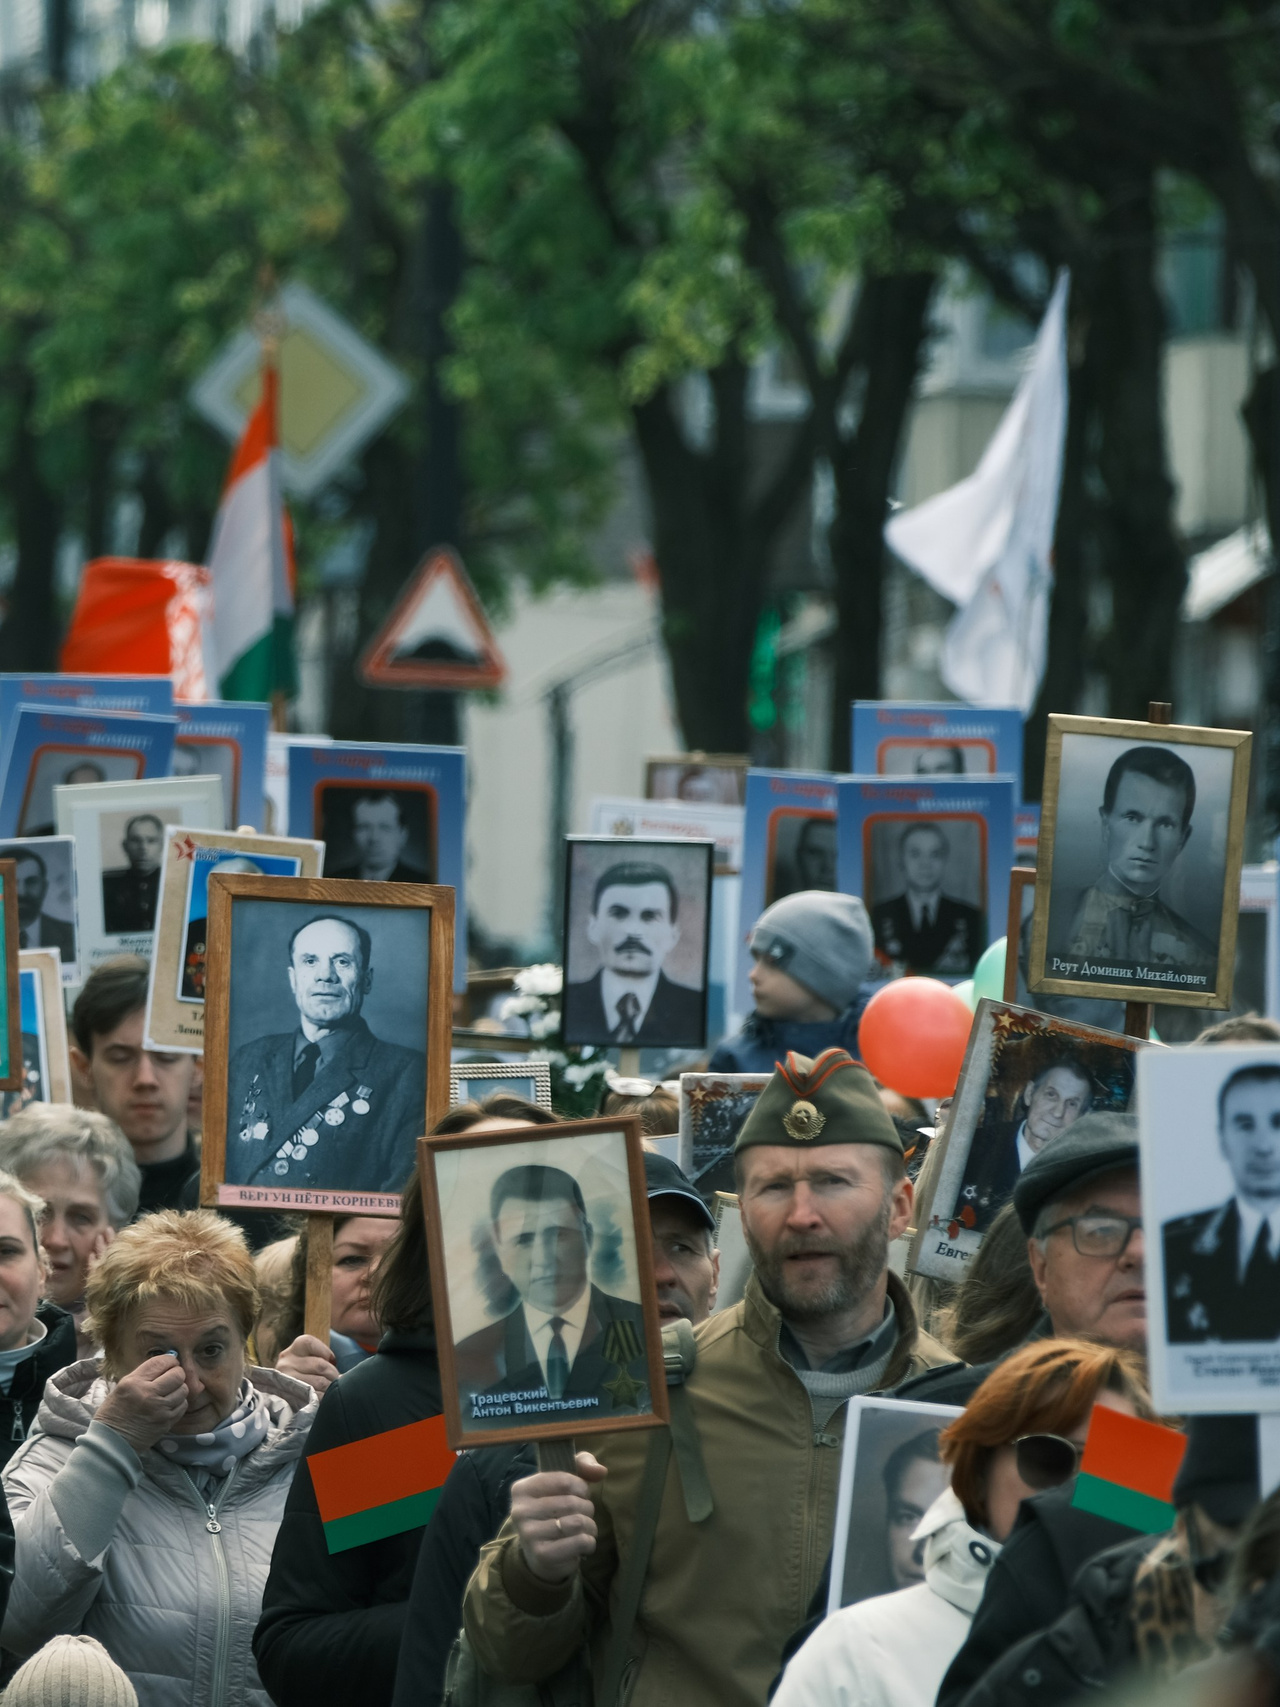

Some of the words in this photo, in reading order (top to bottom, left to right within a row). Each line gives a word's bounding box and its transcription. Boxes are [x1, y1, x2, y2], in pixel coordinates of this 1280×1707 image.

[1052, 958, 1079, 975] Реут
[1080, 961, 1133, 979] Доминик
[1135, 966, 1207, 985] Михайлович
[294, 1191, 329, 1205] ПЁТР
[935, 1241, 970, 1260] Евге
[470, 1386, 548, 1407] Трацевский
[472, 1406, 512, 1418] Антон
[515, 1397, 599, 1414] Викентьевич
